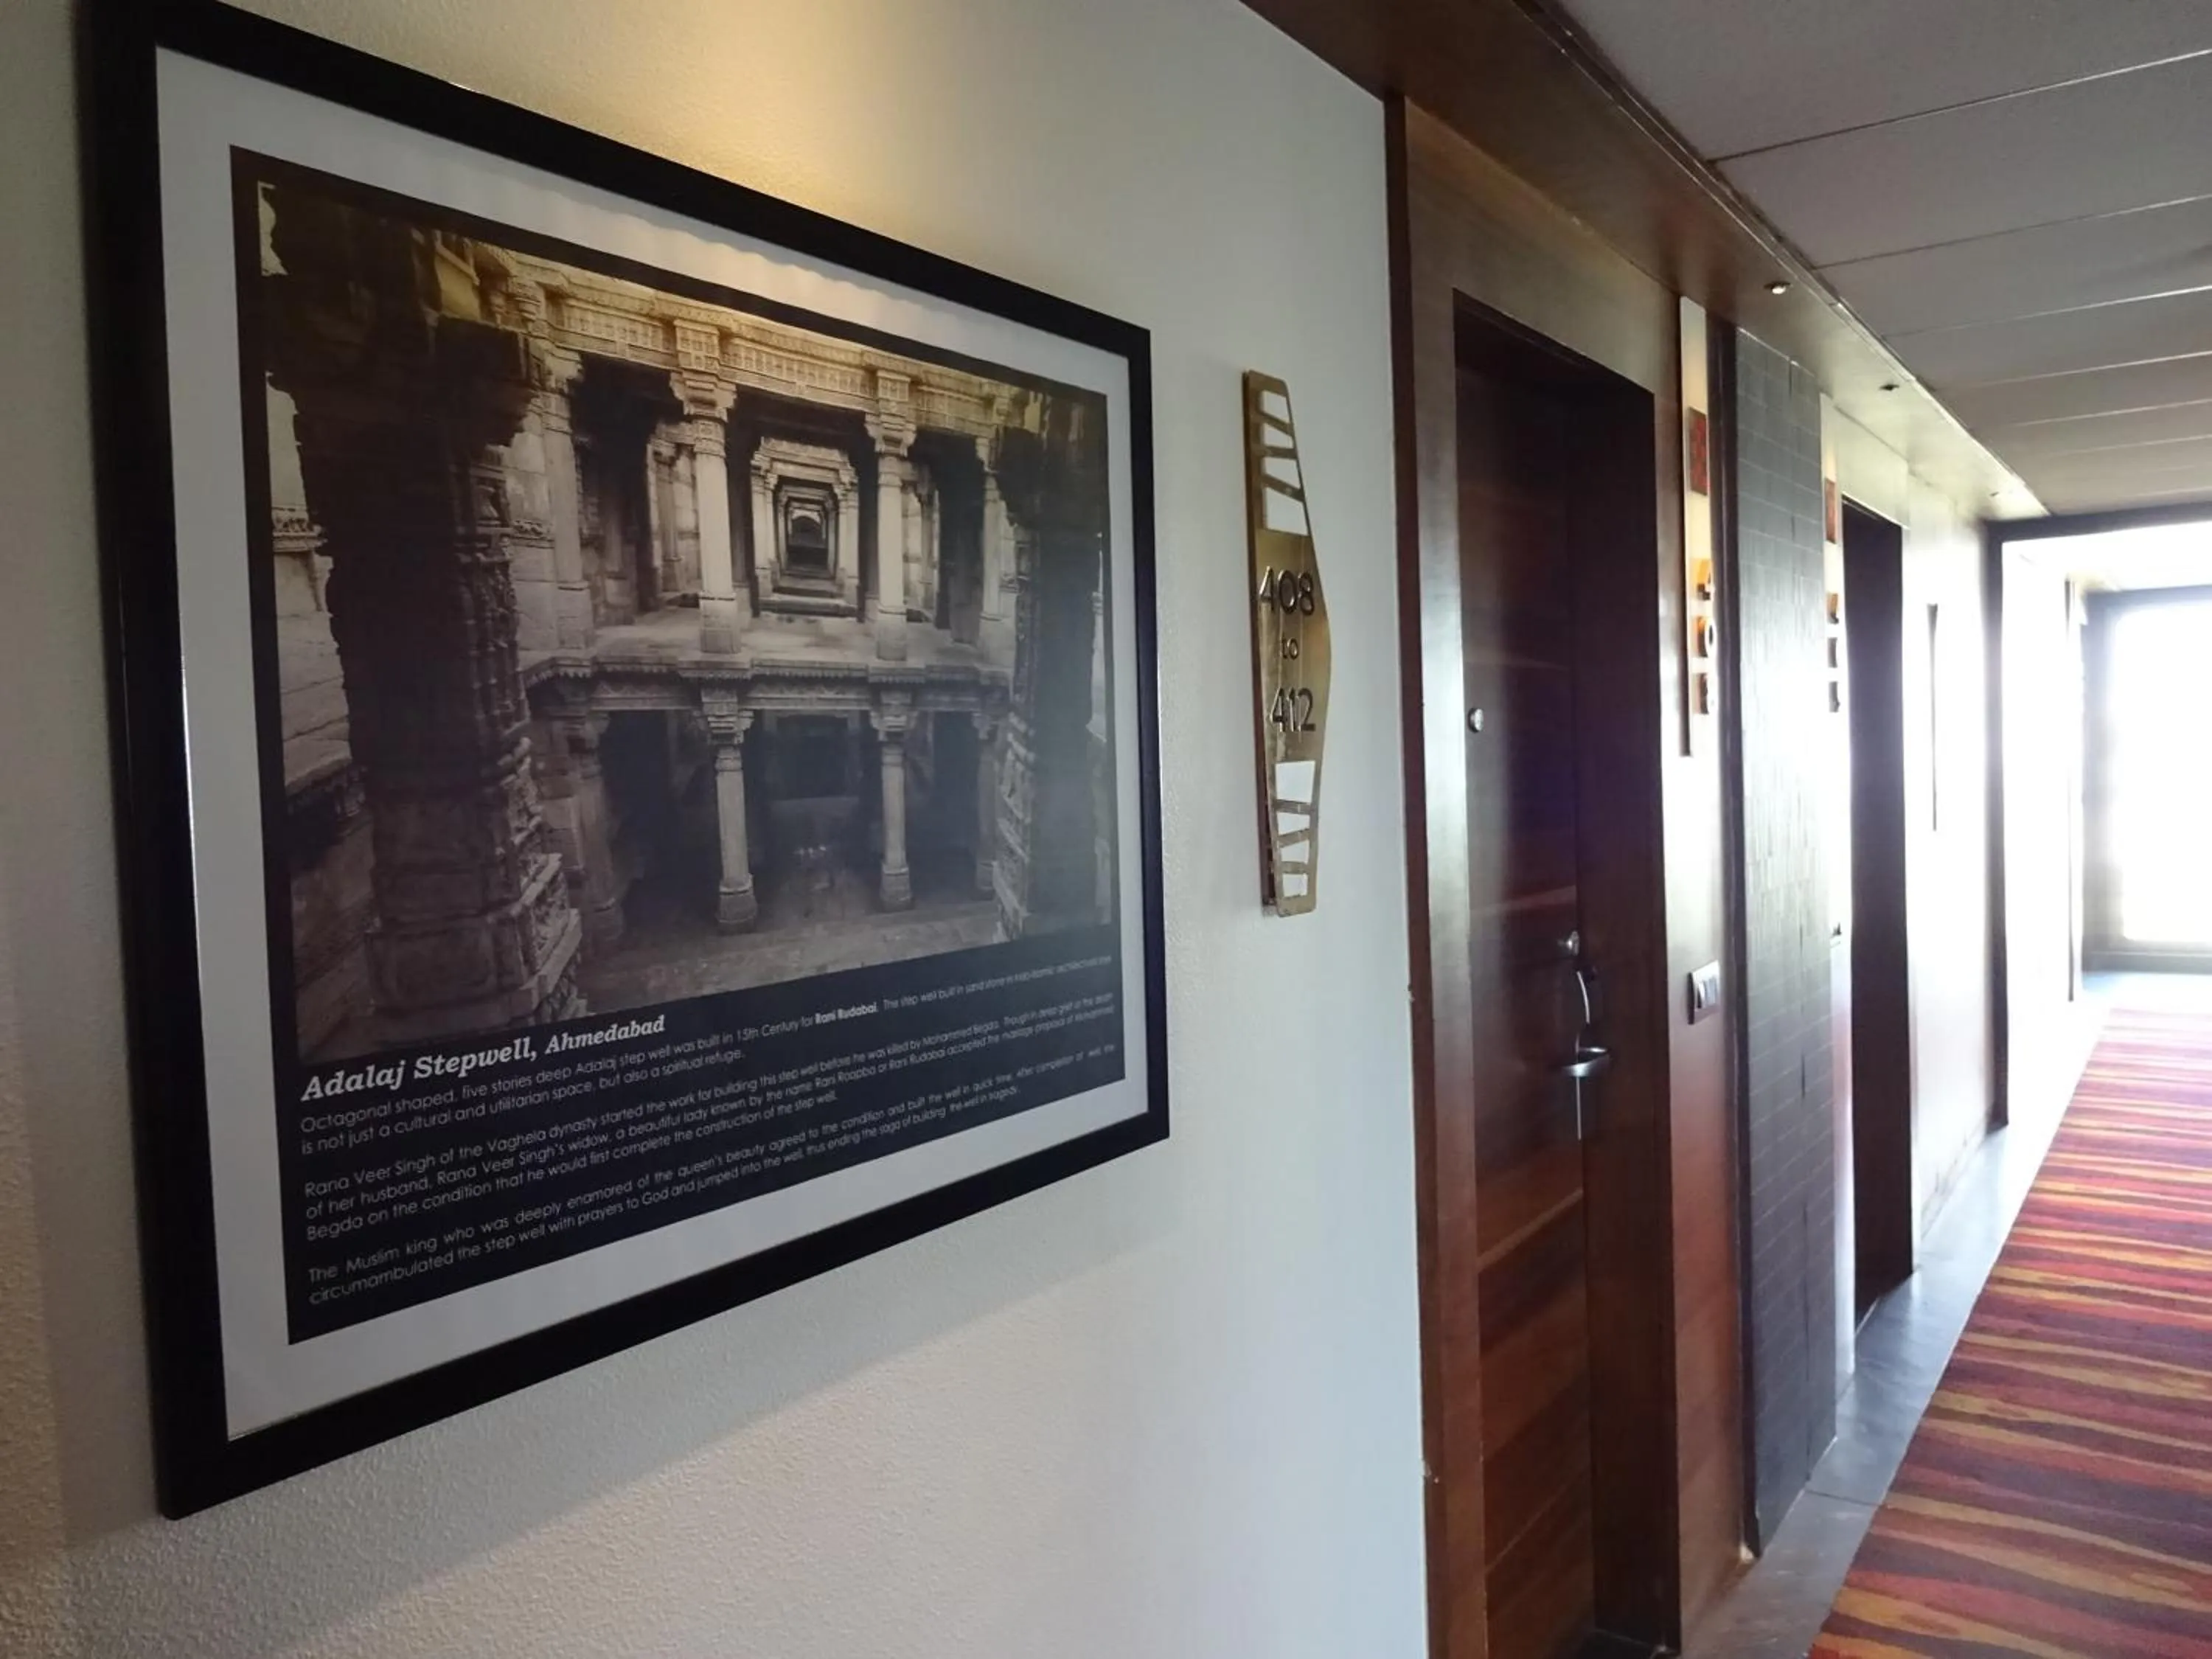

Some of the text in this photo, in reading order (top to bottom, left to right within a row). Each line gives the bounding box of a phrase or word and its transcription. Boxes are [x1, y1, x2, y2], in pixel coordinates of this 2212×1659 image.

[1259, 566, 1315, 616] 408
[1281, 632, 1299, 660] to
[1270, 687, 1315, 732] 412
[300, 1101, 391, 1133] Octagonal
[462, 1085, 487, 1099] five
[491, 1075, 532, 1093] stories
[535, 1068, 571, 1084] deep
[574, 1055, 616, 1076] Adalaj
[619, 1052, 644, 1066] step
[649, 1044, 669, 1060] well
[674, 1042, 696, 1054] was
[698, 1034, 720, 1050] built
[723, 1032, 733, 1044] in
[737, 1025, 758, 1041] 15th
[760, 1019, 799, 1036] Century
[800, 1015, 813, 1027] for
[815, 1009, 835, 1024] Rani
[301, 1013, 665, 1101] Adalaj Stepwell, Ahmedabad
[301, 1140, 313, 1155] is
[317, 1132, 344, 1151] not
[347, 1126, 373, 1149] just
[378, 1126, 390, 1138] a
[394, 1110, 451, 1134] cultural
[454, 1102, 486, 1121] and
[599, 1073, 619, 1089] but
[623, 1069, 648, 1084] also
[650, 1067, 660, 1078] a
[304, 1176, 348, 1197] Rana
[353, 1166, 390, 1186] Veer
[394, 1152, 435, 1175] Singh
[439, 1147, 453, 1164] of
[459, 1143, 482, 1159] the
[487, 1128, 546, 1152] Vaghela
[549, 1116, 597, 1139] dynasty
[600, 1103, 642, 1124] started
[646, 1099, 665, 1113] the
[668, 1091, 695, 1108] work
[698, 1089, 711, 1102] for
[306, 1200, 323, 1220] of
[328, 1197, 355, 1214] her
[437, 1166, 476, 1186] Rana
[481, 1157, 514, 1175] Veer
[615, 1129, 625, 1140] a
[628, 1112, 680, 1136] beautiful
[684, 1107, 707, 1122] lady
[307, 1214, 364, 1242] Begda
[367, 1209, 387, 1225] on
[393, 1200, 417, 1218] the
[422, 1183, 492, 1211] condition
[495, 1171, 524, 1191] that
[526, 1168, 543, 1183] he
[548, 1154, 586, 1177] would
[589, 1148, 609, 1166] first
[613, 1134, 669, 1159] complete
[675, 1128, 692, 1143] the
[307, 1263, 338, 1284] The
[346, 1247, 399, 1273] Muslim
[406, 1237, 437, 1256] king
[443, 1225, 475, 1245] who
[480, 1216, 509, 1234] was
[515, 1200, 562, 1223] deeply
[566, 1178, 631, 1209] enamored
[636, 1173, 650, 1189] of
[654, 1169, 673, 1183] the
[307, 1250, 453, 1307] circumambulated
[458, 1244, 480, 1261] the
[484, 1234, 515, 1253] step
[520, 1222, 545, 1242] well
[549, 1214, 575, 1234] with
[577, 1203, 624, 1228] prayers
[626, 1197, 639, 1211] to
[642, 1186, 669, 1206] God
[672, 1178, 695, 1197] and
